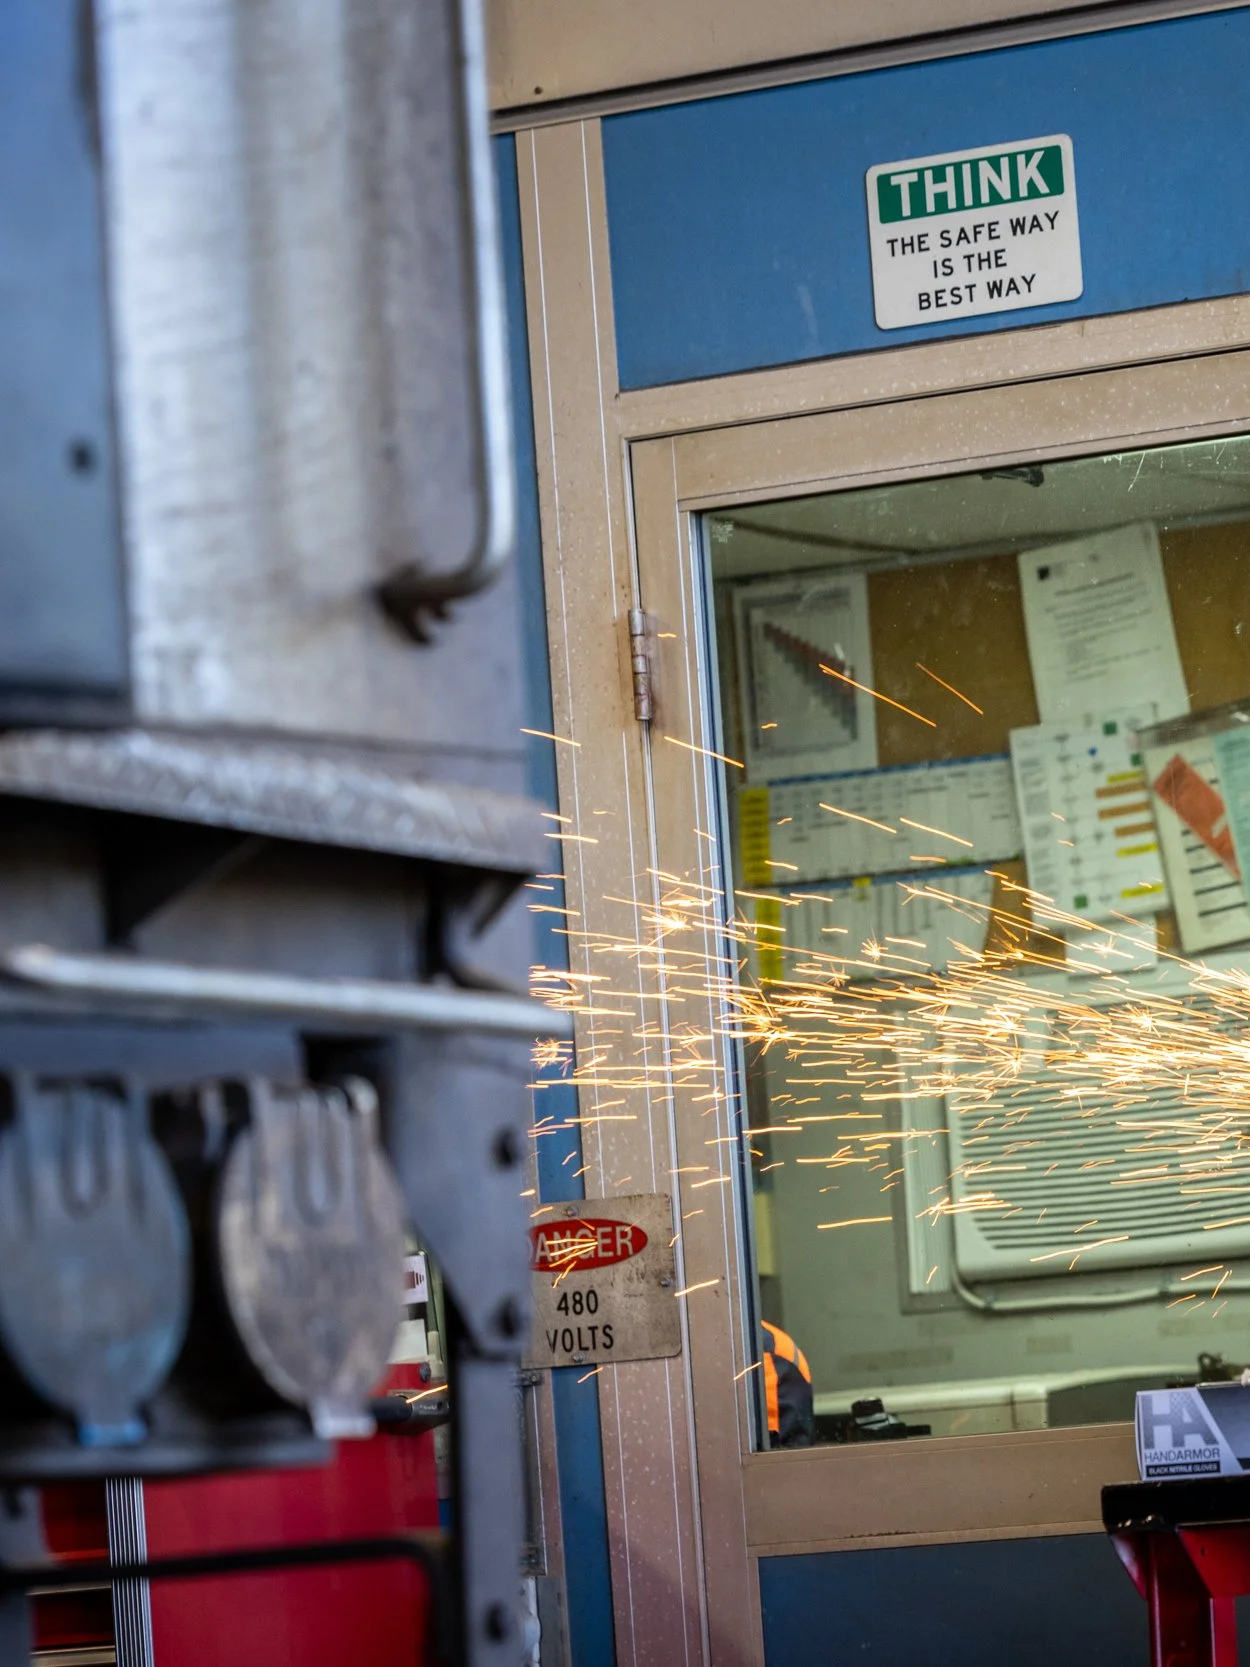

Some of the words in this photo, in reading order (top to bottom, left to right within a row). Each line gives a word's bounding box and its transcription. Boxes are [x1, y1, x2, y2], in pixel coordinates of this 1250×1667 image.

[890, 150, 1050, 217] THINK
[886, 233, 930, 257] THE
[939, 221, 1001, 249] SAFE
[1009, 210, 1059, 236] WAY
[932, 257, 954, 278] IS
[963, 248, 1007, 273] THE
[918, 284, 977, 311] BEST
[986, 274, 1036, 300] WAY
[556, 1289, 599, 1316] 480
[545, 1323, 614, 1354] VOLTS
[1144, 1447, 1220, 1463] HANDARMOR
[1148, 1466, 1168, 1475] BLACK
[1192, 1463, 1218, 1472] GLOVES
